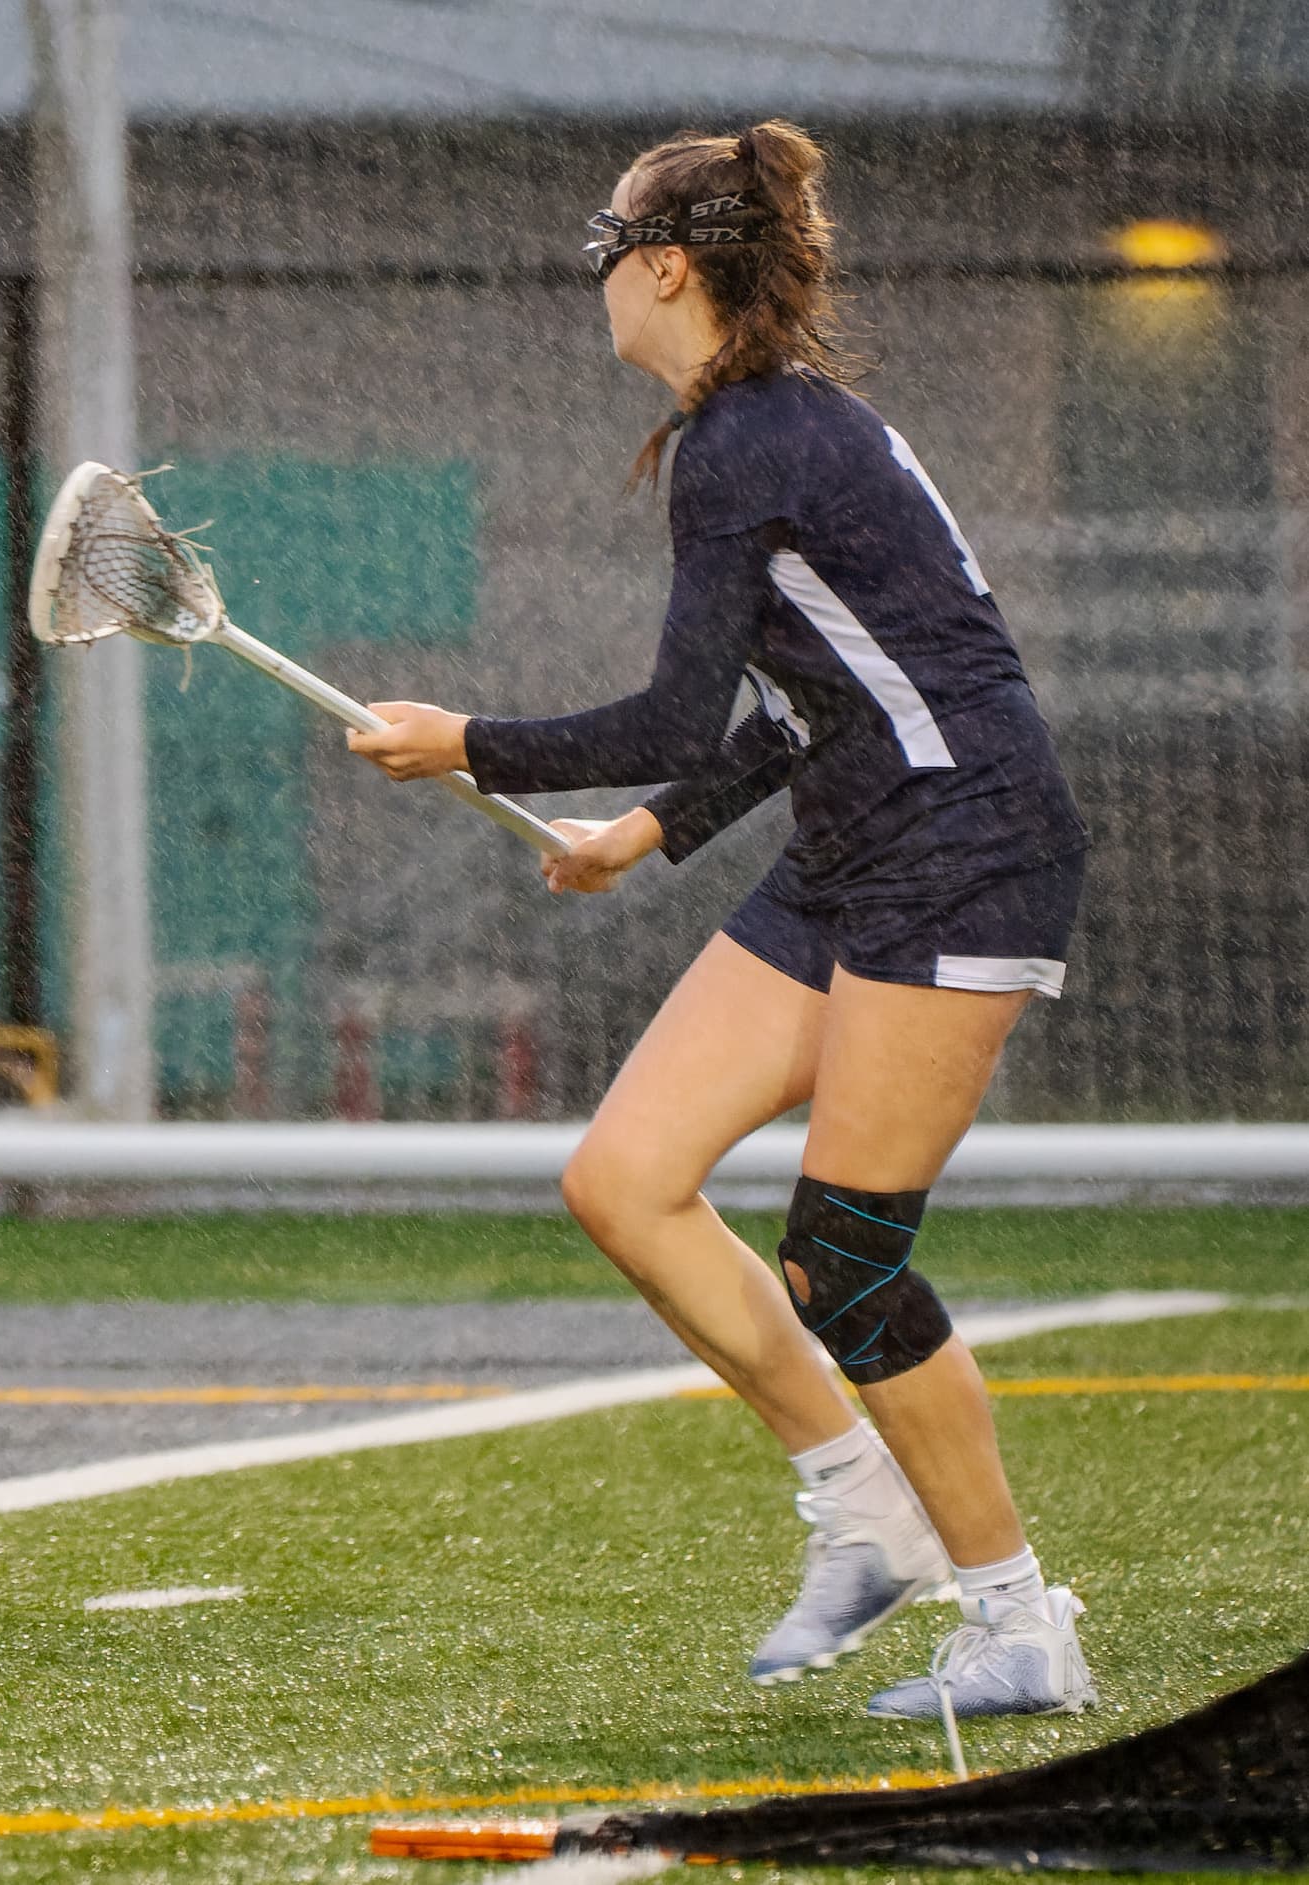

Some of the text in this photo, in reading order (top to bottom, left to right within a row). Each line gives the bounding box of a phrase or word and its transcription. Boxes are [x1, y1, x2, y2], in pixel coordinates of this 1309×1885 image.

[690, 193, 745, 220] STX
[624, 227, 744, 242] STX STX
